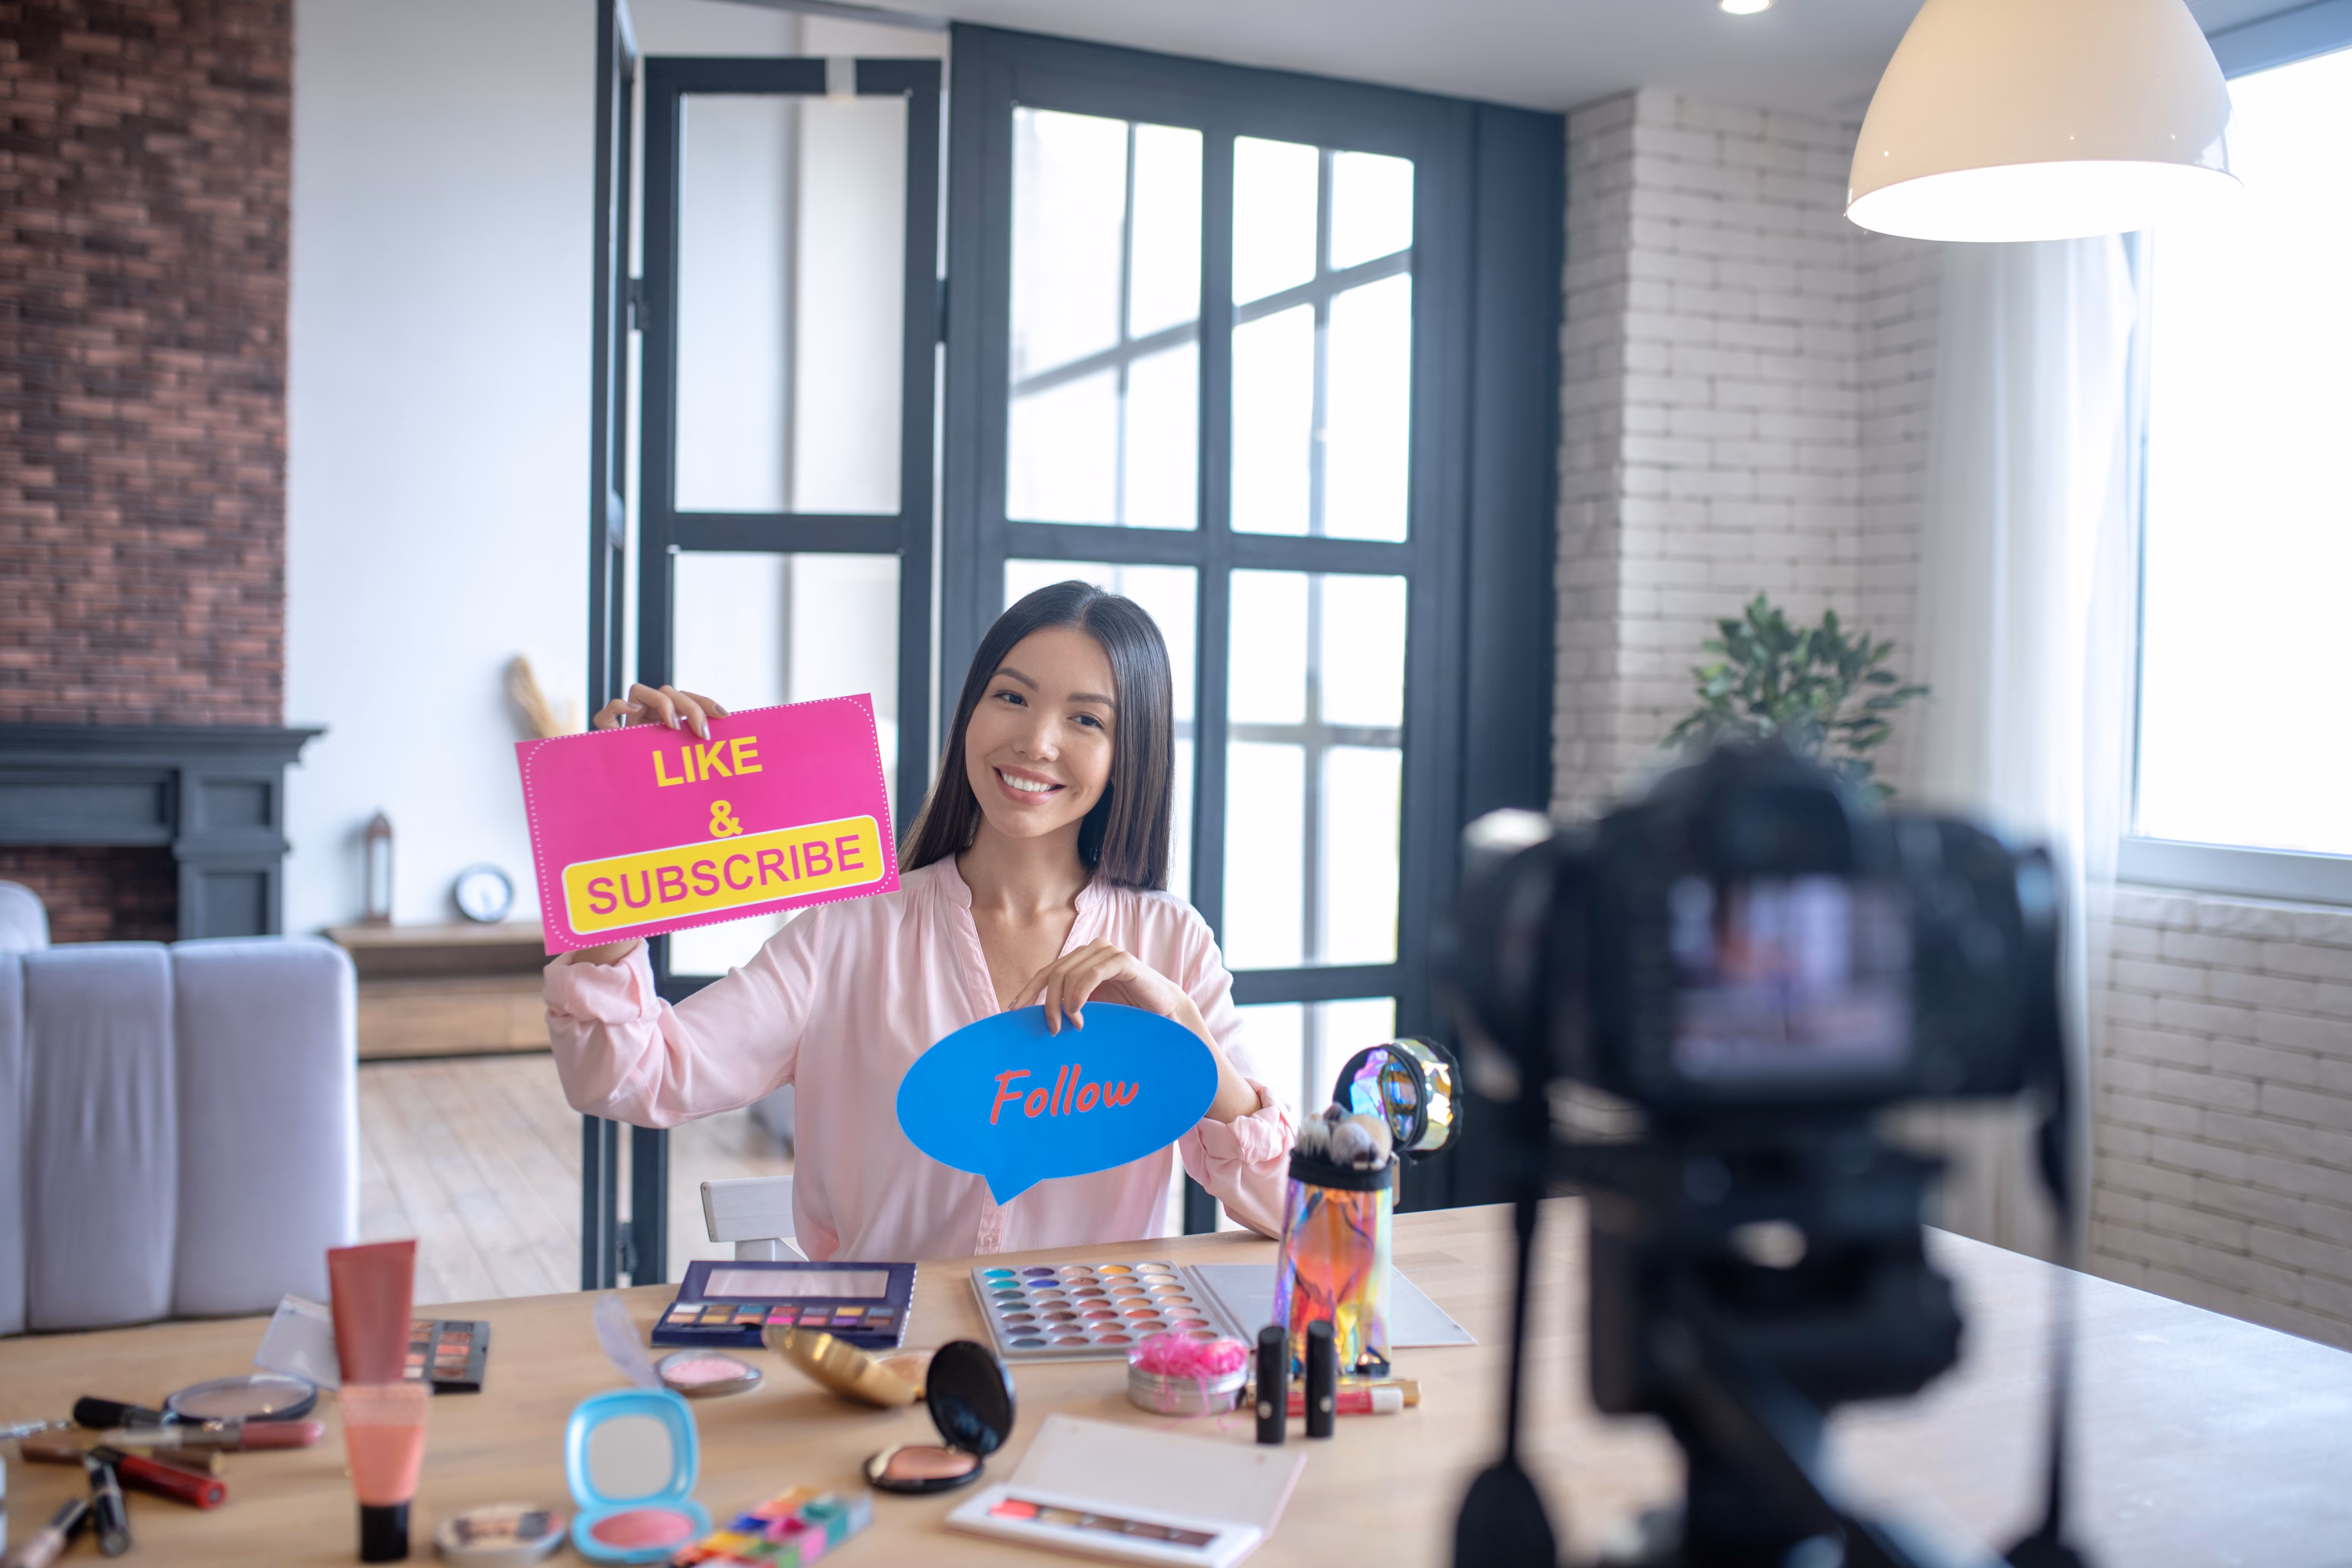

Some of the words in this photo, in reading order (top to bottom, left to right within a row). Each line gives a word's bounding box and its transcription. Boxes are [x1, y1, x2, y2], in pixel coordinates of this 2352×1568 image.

[653, 736, 763, 787] LIKE
[709, 799, 743, 838] &
[587, 834, 865, 915] SUBSCRIBE
[990, 1064, 1139, 1125] Follow
